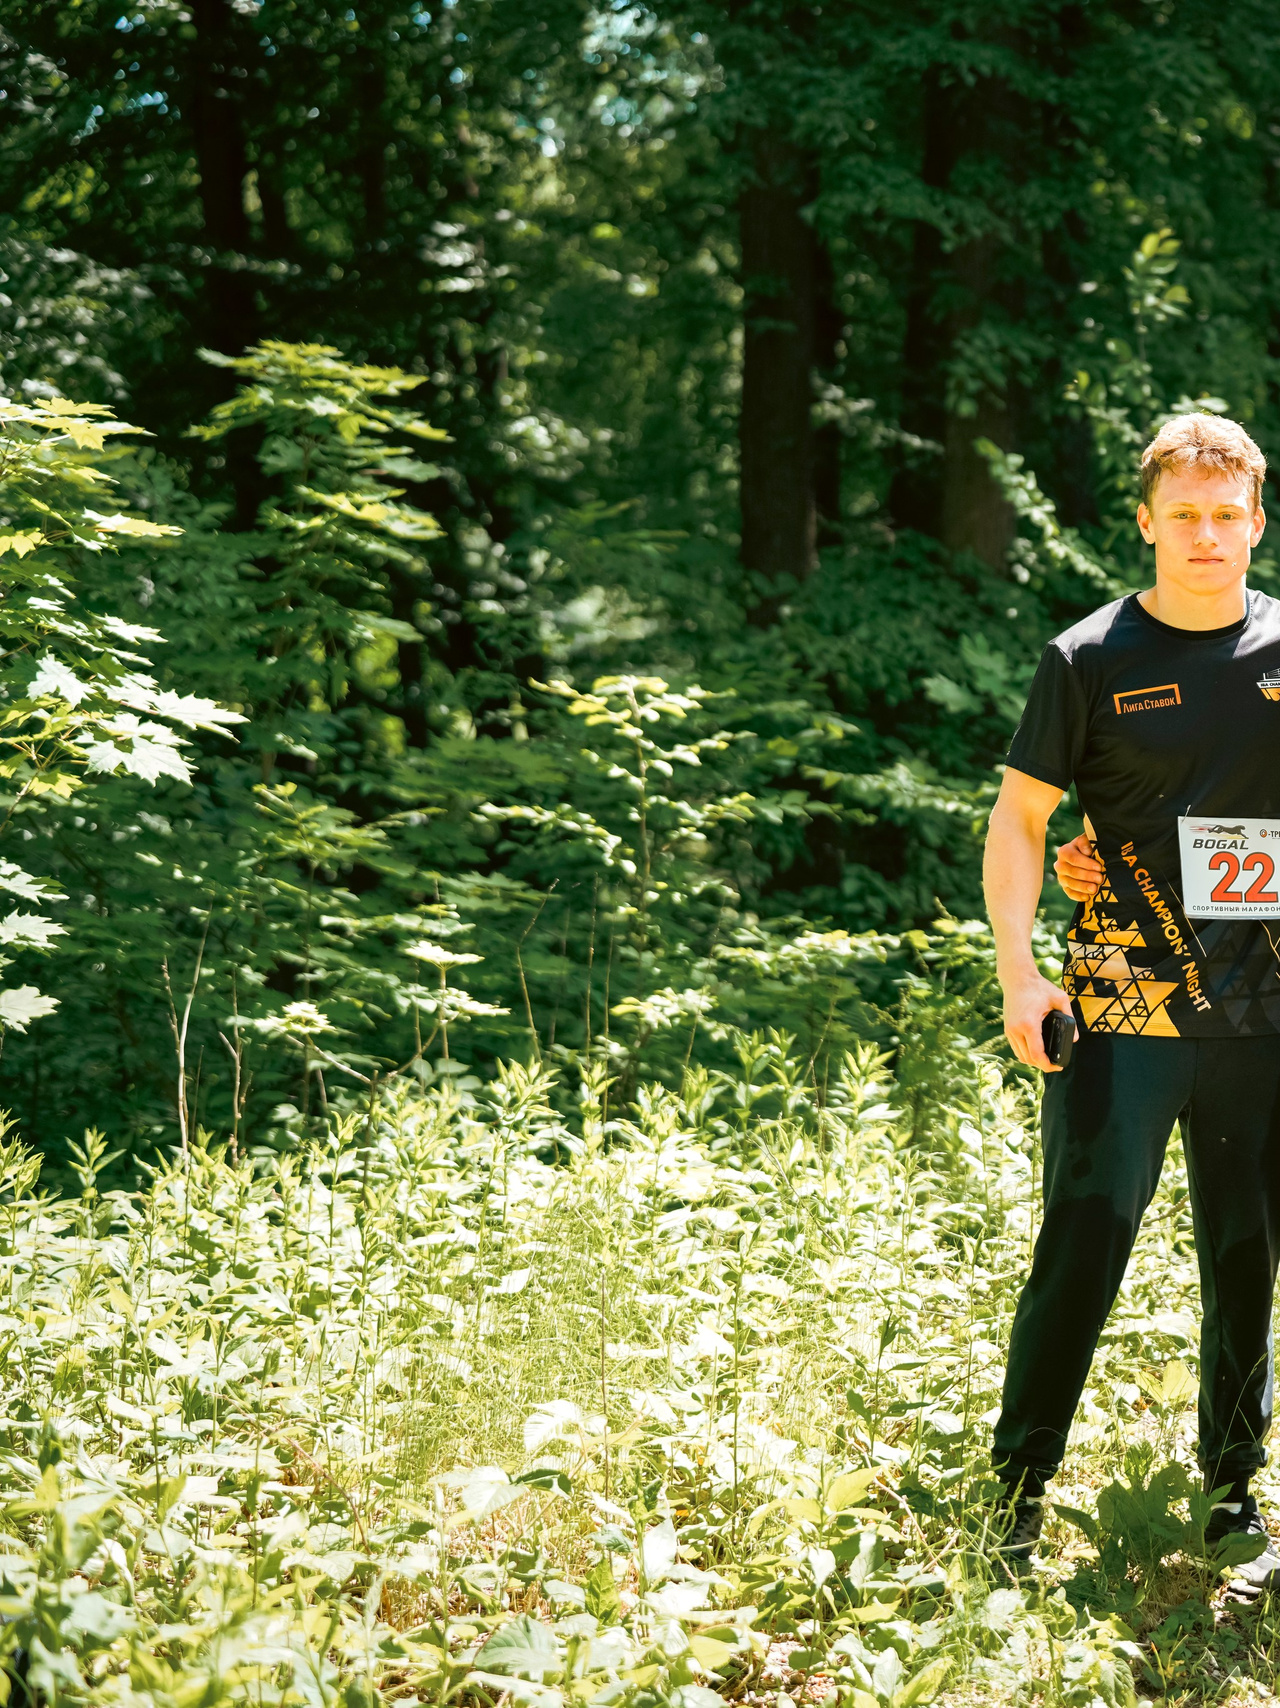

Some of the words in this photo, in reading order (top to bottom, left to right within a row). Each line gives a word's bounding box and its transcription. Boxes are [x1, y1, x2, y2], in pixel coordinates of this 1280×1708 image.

[1192, 839, 1249, 850] BOGAL
[1208, 851, 1279, 903] 22
[1182, 961, 1212, 1012] NIGHT
